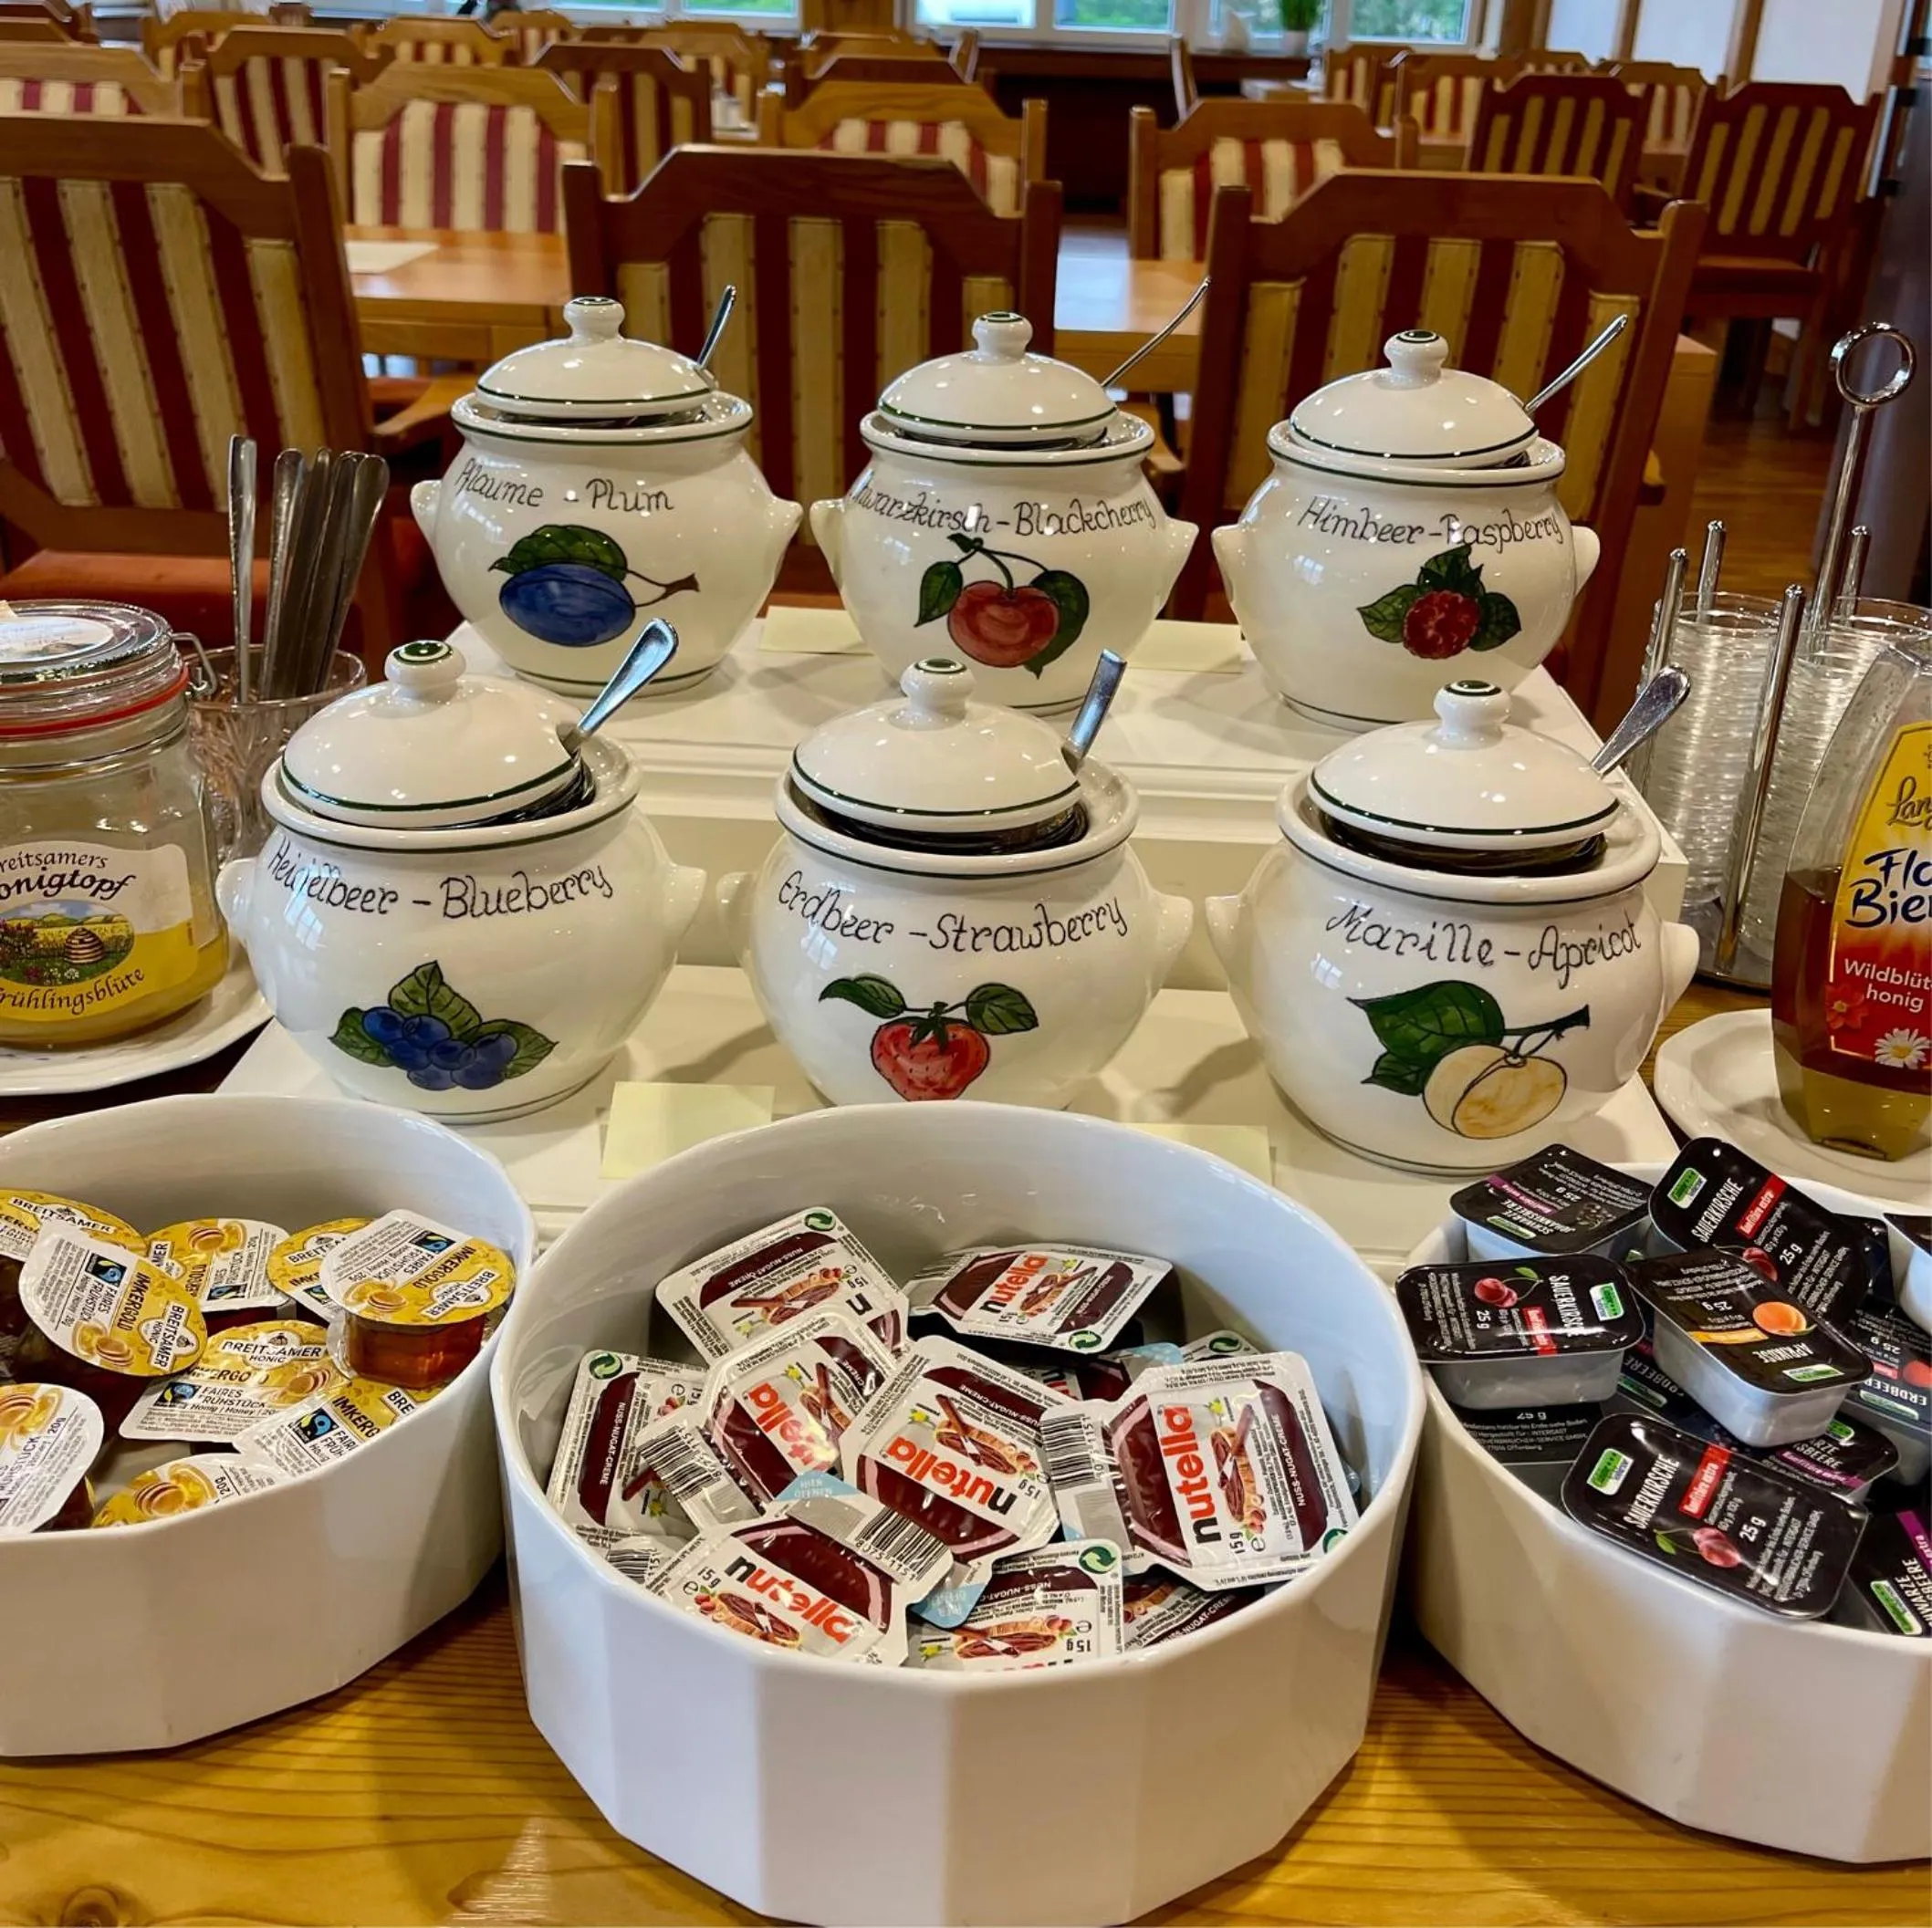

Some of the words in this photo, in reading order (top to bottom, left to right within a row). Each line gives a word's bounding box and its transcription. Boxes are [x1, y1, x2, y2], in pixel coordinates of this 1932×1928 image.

[585, 477, 674, 512] Plum
[1887, 776, 1932, 827] Lan
[0, 850, 109, 873] reitsamers
[0, 867, 136, 901] onigtopf
[1864, 848, 1932, 891] Flo
[440, 862, 613, 919] Blueberry
[778, 870, 894, 943] Erdbeer
[1844, 879, 1932, 928] Bie
[1844, 958, 1932, 990] Wildblüt
[1866, 984, 1924, 1013] honig
[1691, 1177, 1744, 1243] SAUERKIRSCHE
[413, 1245, 475, 1289] IMKERGOLD
[1780, 1251, 1795, 1266] 25
[116, 1272, 151, 1332] IMKERGOLD
[426, 1270, 496, 1317] BREITSAMER
[979, 1255, 1049, 1314] nutella
[1550, 1274, 1586, 1338] SAUERKIRSCE
[1715, 1301, 1732, 1312] 25
[153, 1305, 185, 1369] BREITSAMER
[1476, 1309, 1491, 1321] 25
[202, 1387, 243, 1398] FAIRES
[333, 1396, 380, 1439] IMKERG
[333, 1432, 358, 1452] FAIR
[885, 1436, 1018, 1516] nutella
[1161, 1405, 1222, 1544] nutella
[1624, 1454, 1680, 1529] SAUERKIRSCHE
[1739, 1523, 1759, 1542] 25
[724, 1556, 853, 1644] nutella
